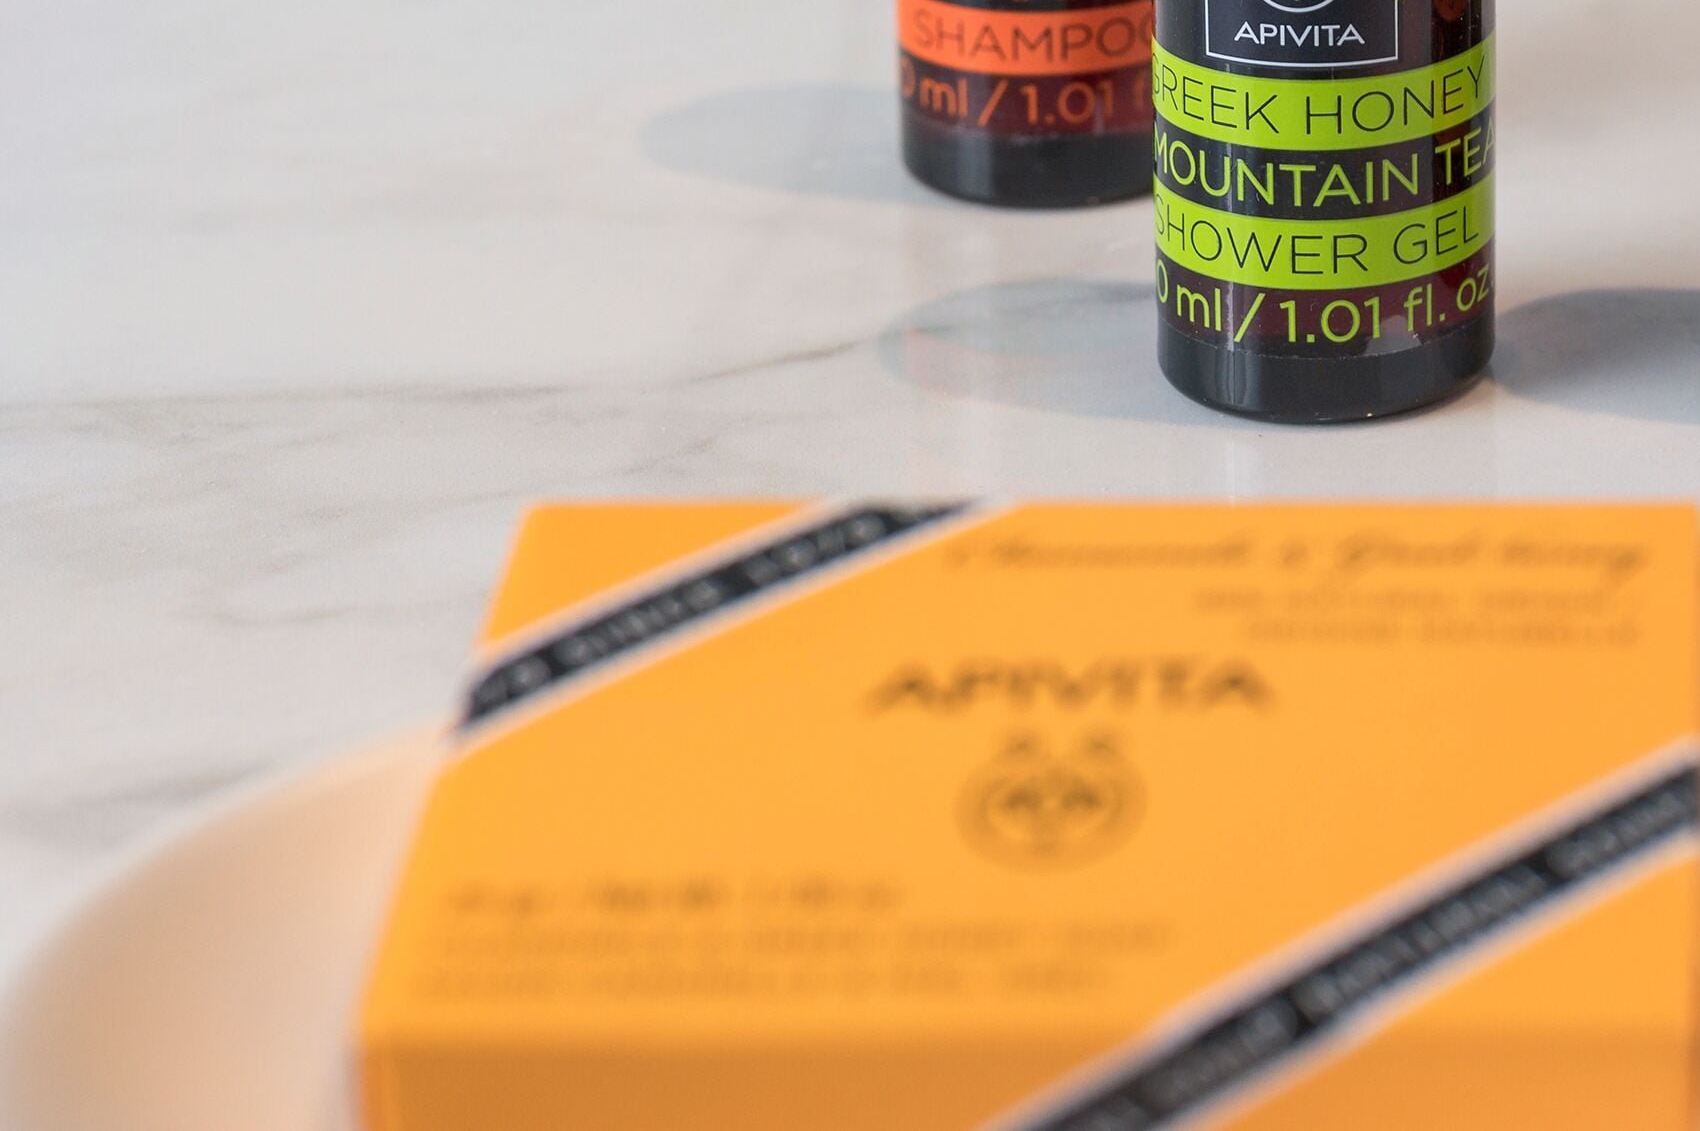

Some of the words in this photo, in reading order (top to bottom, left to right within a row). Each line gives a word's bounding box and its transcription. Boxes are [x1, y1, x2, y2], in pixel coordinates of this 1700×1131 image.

[1234, 21, 1366, 47] APIVITA
[919, 76, 968, 119] ml
[1020, 80, 1114, 127] 1.01
[1305, 54, 1485, 135] HONEY
[1154, 121, 1420, 208] MOUNTAIN
[1435, 116, 1495, 186] TEA
[1155, 193, 1368, 275] SHOWER
[1394, 205, 1480, 265] GEL
[1176, 282, 1223, 333] ml
[1234, 292, 1267, 343] /
[1278, 297, 1380, 343] 1.01
[1403, 282, 1447, 333] fl.
